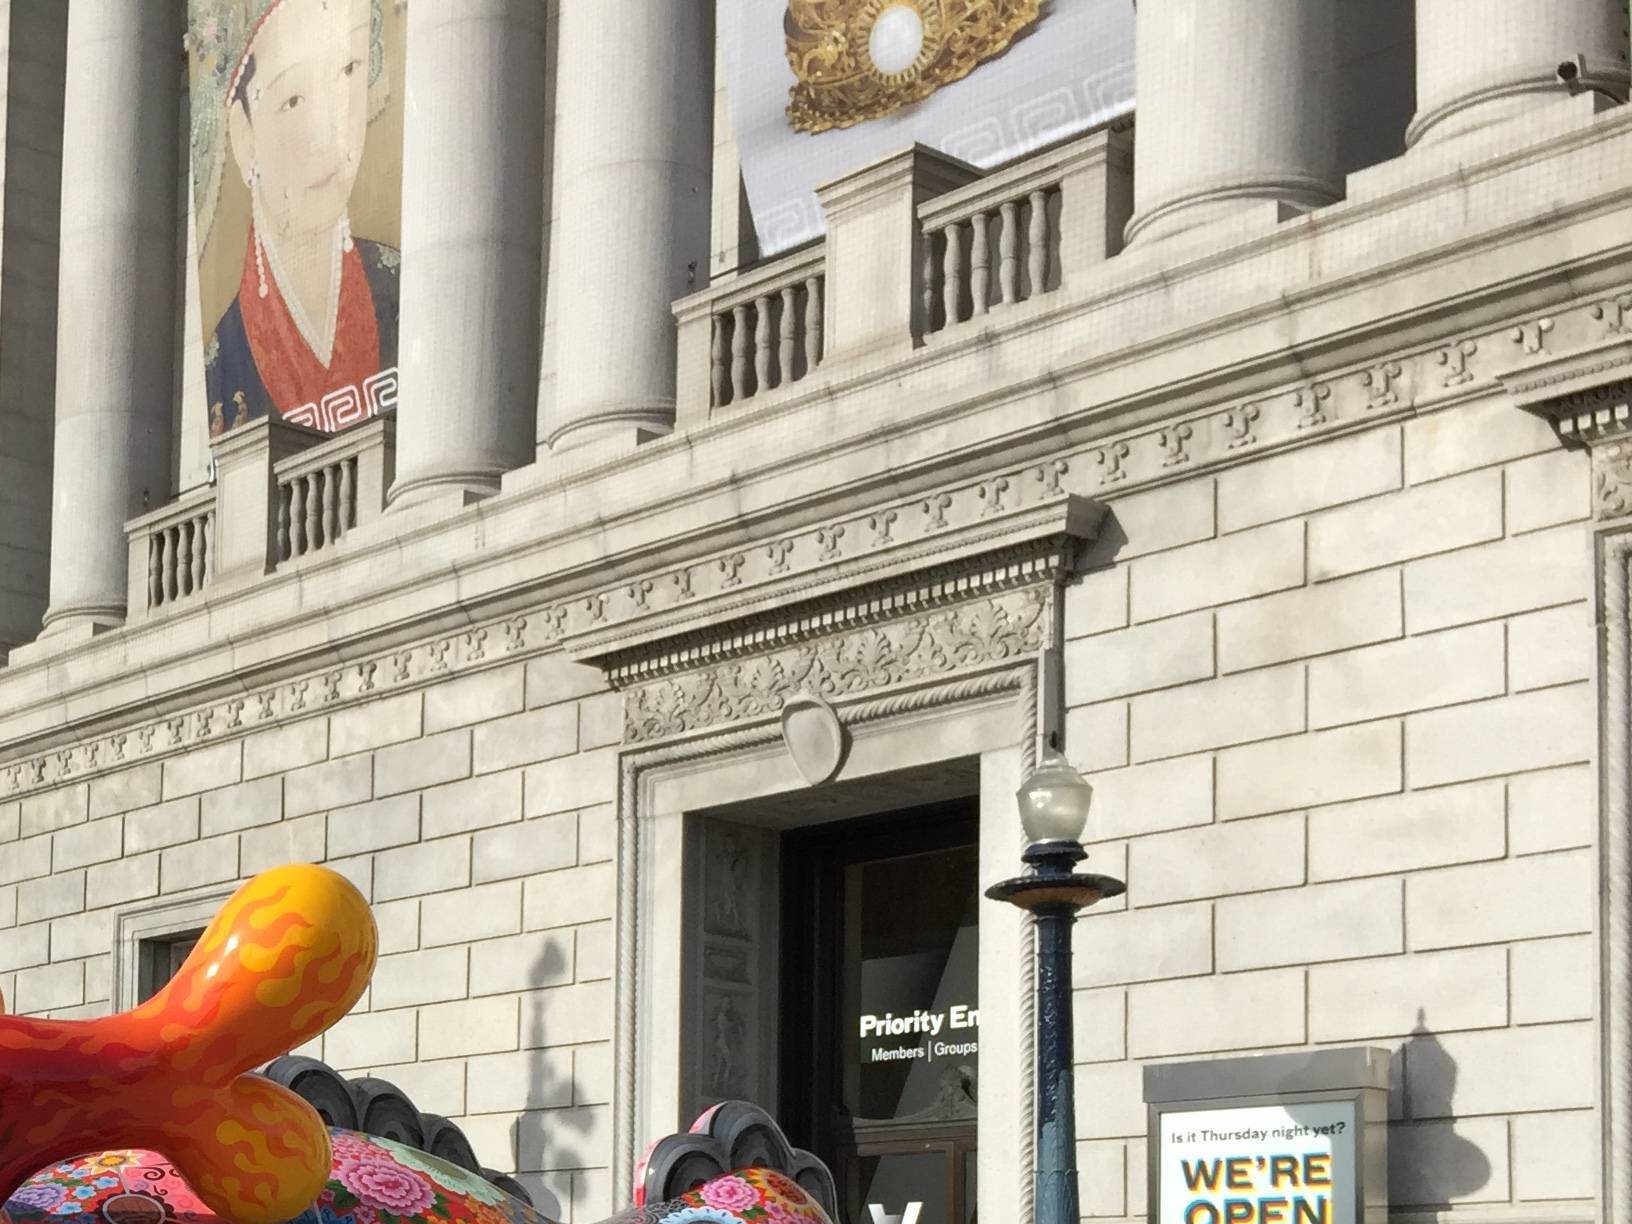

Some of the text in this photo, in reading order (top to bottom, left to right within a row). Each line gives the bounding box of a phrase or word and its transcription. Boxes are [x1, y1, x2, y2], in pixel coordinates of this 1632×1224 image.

[860, 1010, 945, 1038] Priority
[871, 1042, 978, 1062] Members Groups
[1172, 1121, 1346, 1144] Is it Thursday night yet?
[1180, 1153, 1331, 1192] WE'RE
